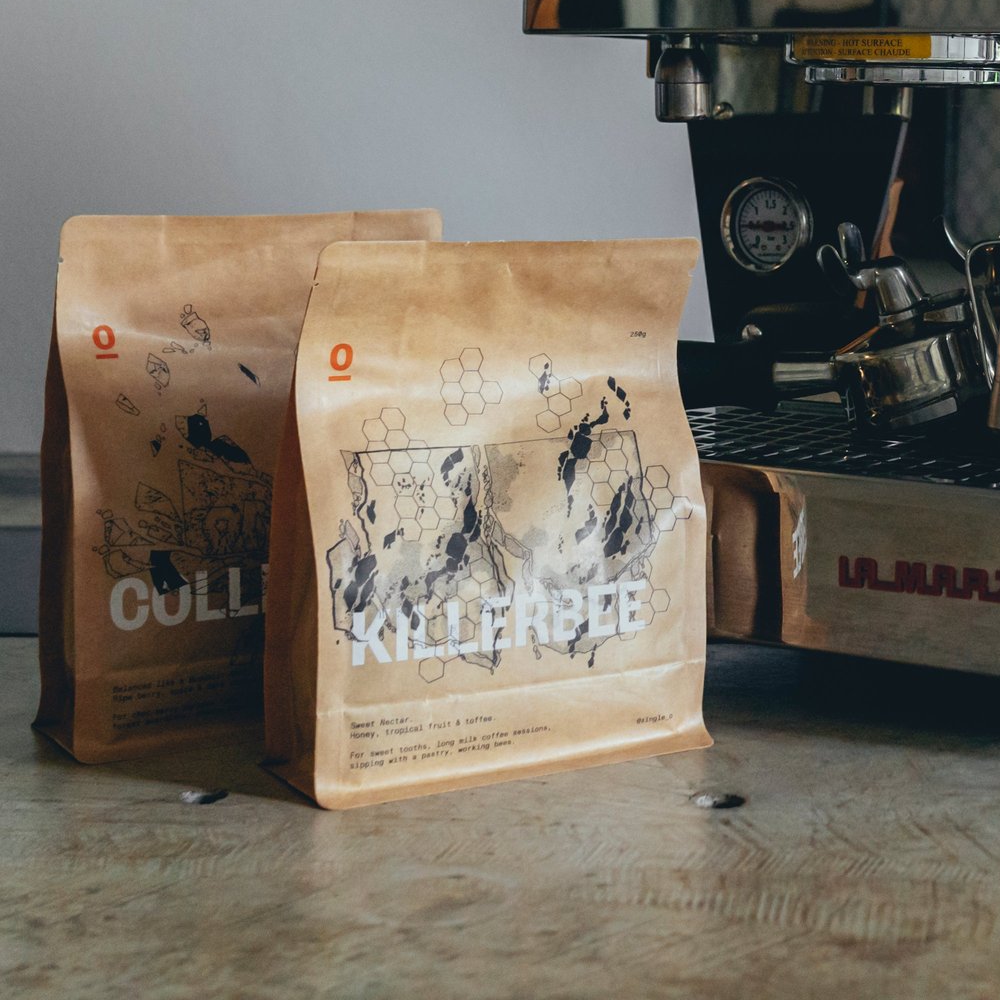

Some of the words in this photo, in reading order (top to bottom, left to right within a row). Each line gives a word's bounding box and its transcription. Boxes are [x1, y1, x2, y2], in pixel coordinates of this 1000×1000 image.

[838, 48, 872, 56] SURFACE
[874, 48, 911, 56] CHAUDE
[843, 39, 859, 47] HOT
[861, 39, 903, 47] SURFACE
[839, 555, 878, 589] LA
[351, 578, 647, 666] KILLERBEE
[350, 721, 375, 730] Sweet
[380, 716, 413, 727] Nectar.
[350, 730, 380, 740] Honey,
[385, 724, 423, 736] tropical
[428, 720, 451, 730] fruit
[455, 718, 461, 727] &
[466, 714, 496, 725] toffee.
[350, 751, 364, 760] For
[370, 748, 393, 758] sweet
[400, 743, 431, 754] tooths,
[437, 739, 455, 749] long
[459, 735, 477, 745] milk
[482, 731, 509, 742] coffee
[513, 725, 551, 737] sessions,
[350, 759, 385, 770] sipping
[389, 755, 407, 765] with
[421, 749, 452, 760] pastry,
[458, 742, 490, 753] working
